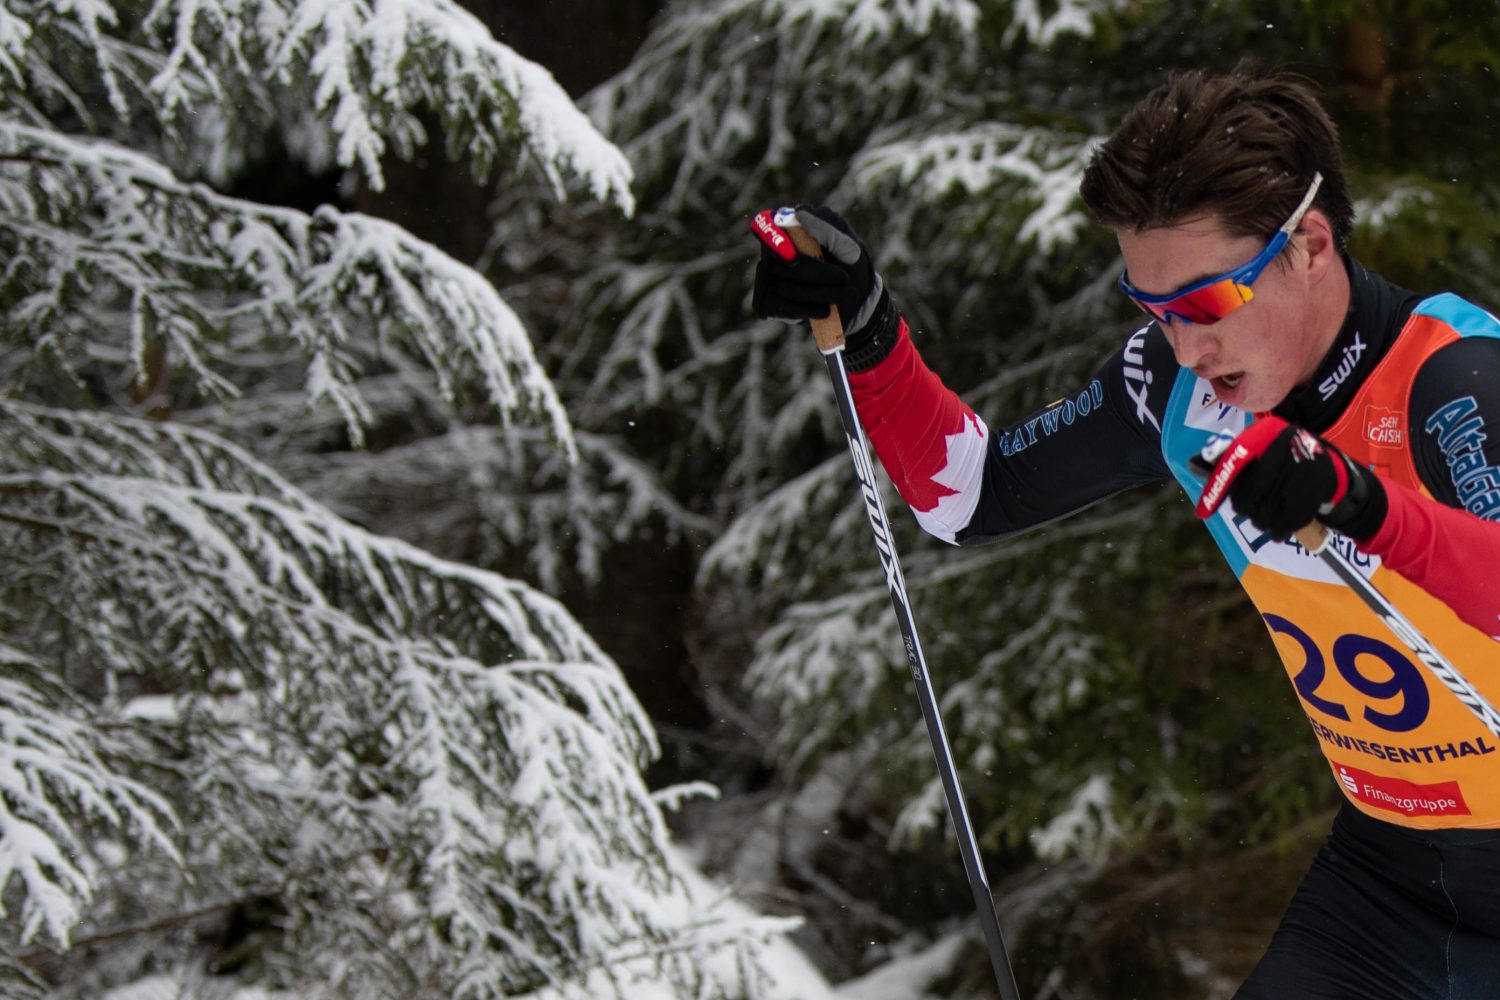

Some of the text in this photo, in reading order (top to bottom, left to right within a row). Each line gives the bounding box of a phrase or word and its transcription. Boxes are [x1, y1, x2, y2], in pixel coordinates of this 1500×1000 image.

[1203, 454, 1238, 511] Auclair
[1262, 612, 1430, 732] 29
[1309, 716, 1496, 763] ERWIESENTHAL
[1363, 784, 1456, 812] Finanzgruppe
